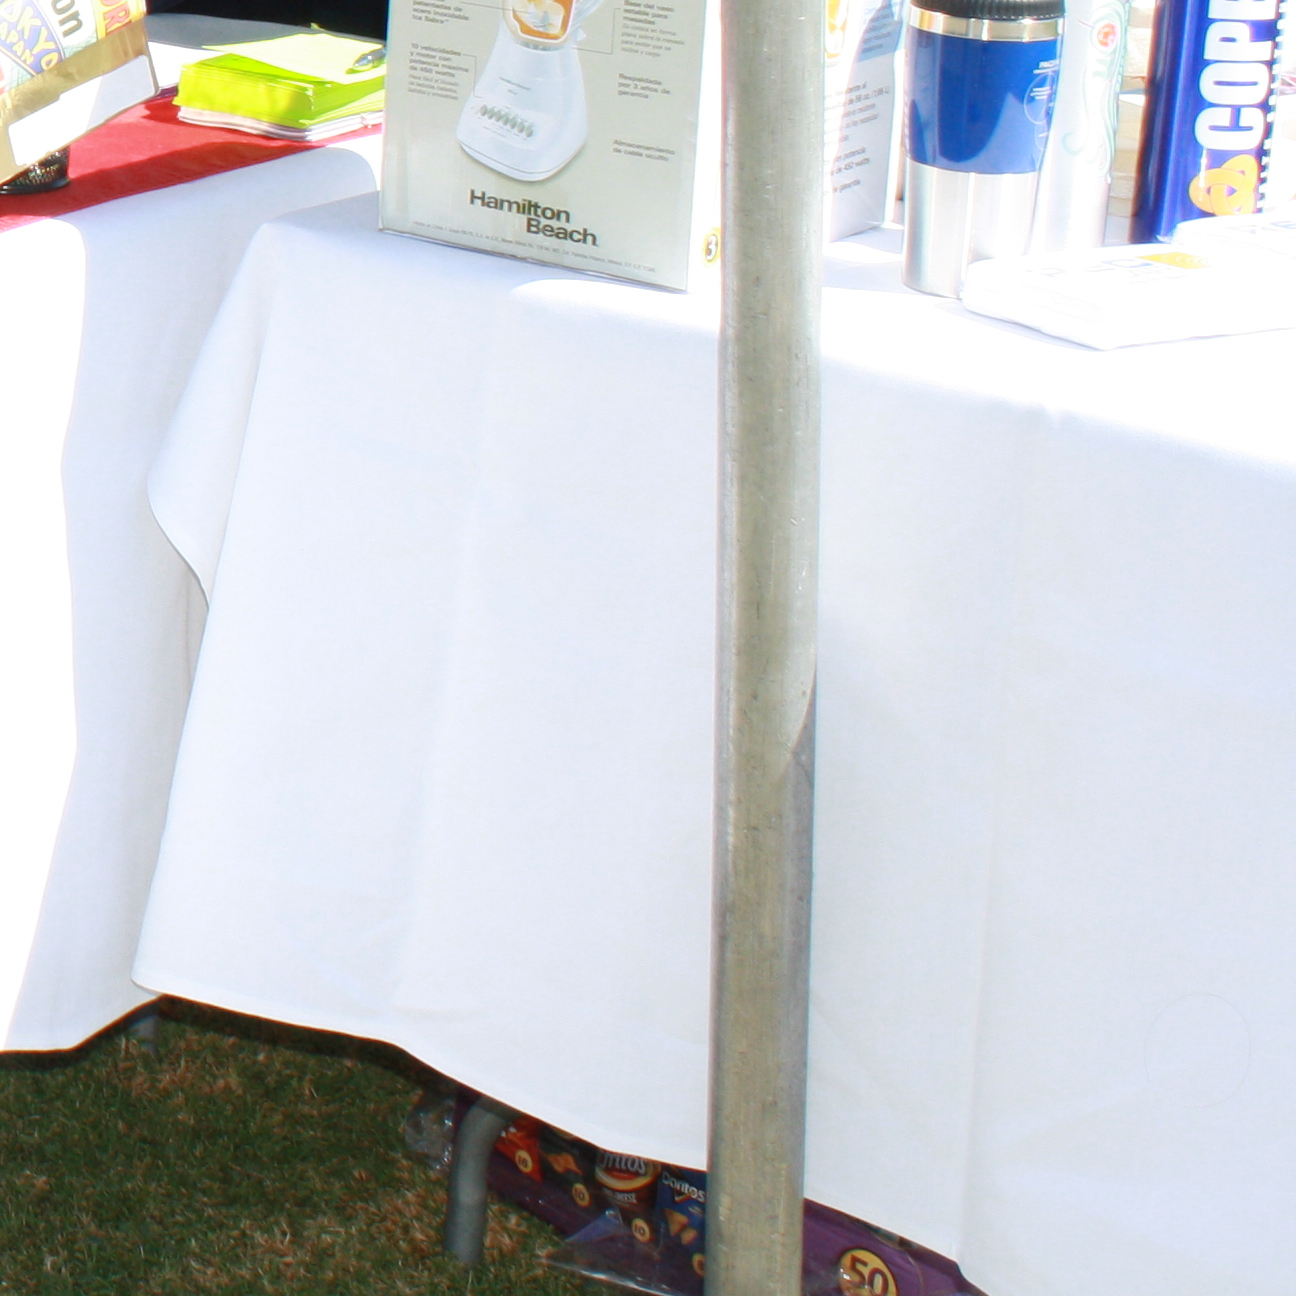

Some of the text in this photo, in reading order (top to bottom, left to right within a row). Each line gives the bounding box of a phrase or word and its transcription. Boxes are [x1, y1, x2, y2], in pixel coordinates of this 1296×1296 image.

[469, 188, 571, 224] Hamilton
[526, 216, 598, 248] Beach
[662, 1170, 707, 1204] Doritos
[850, 1252, 890, 1296] 50
